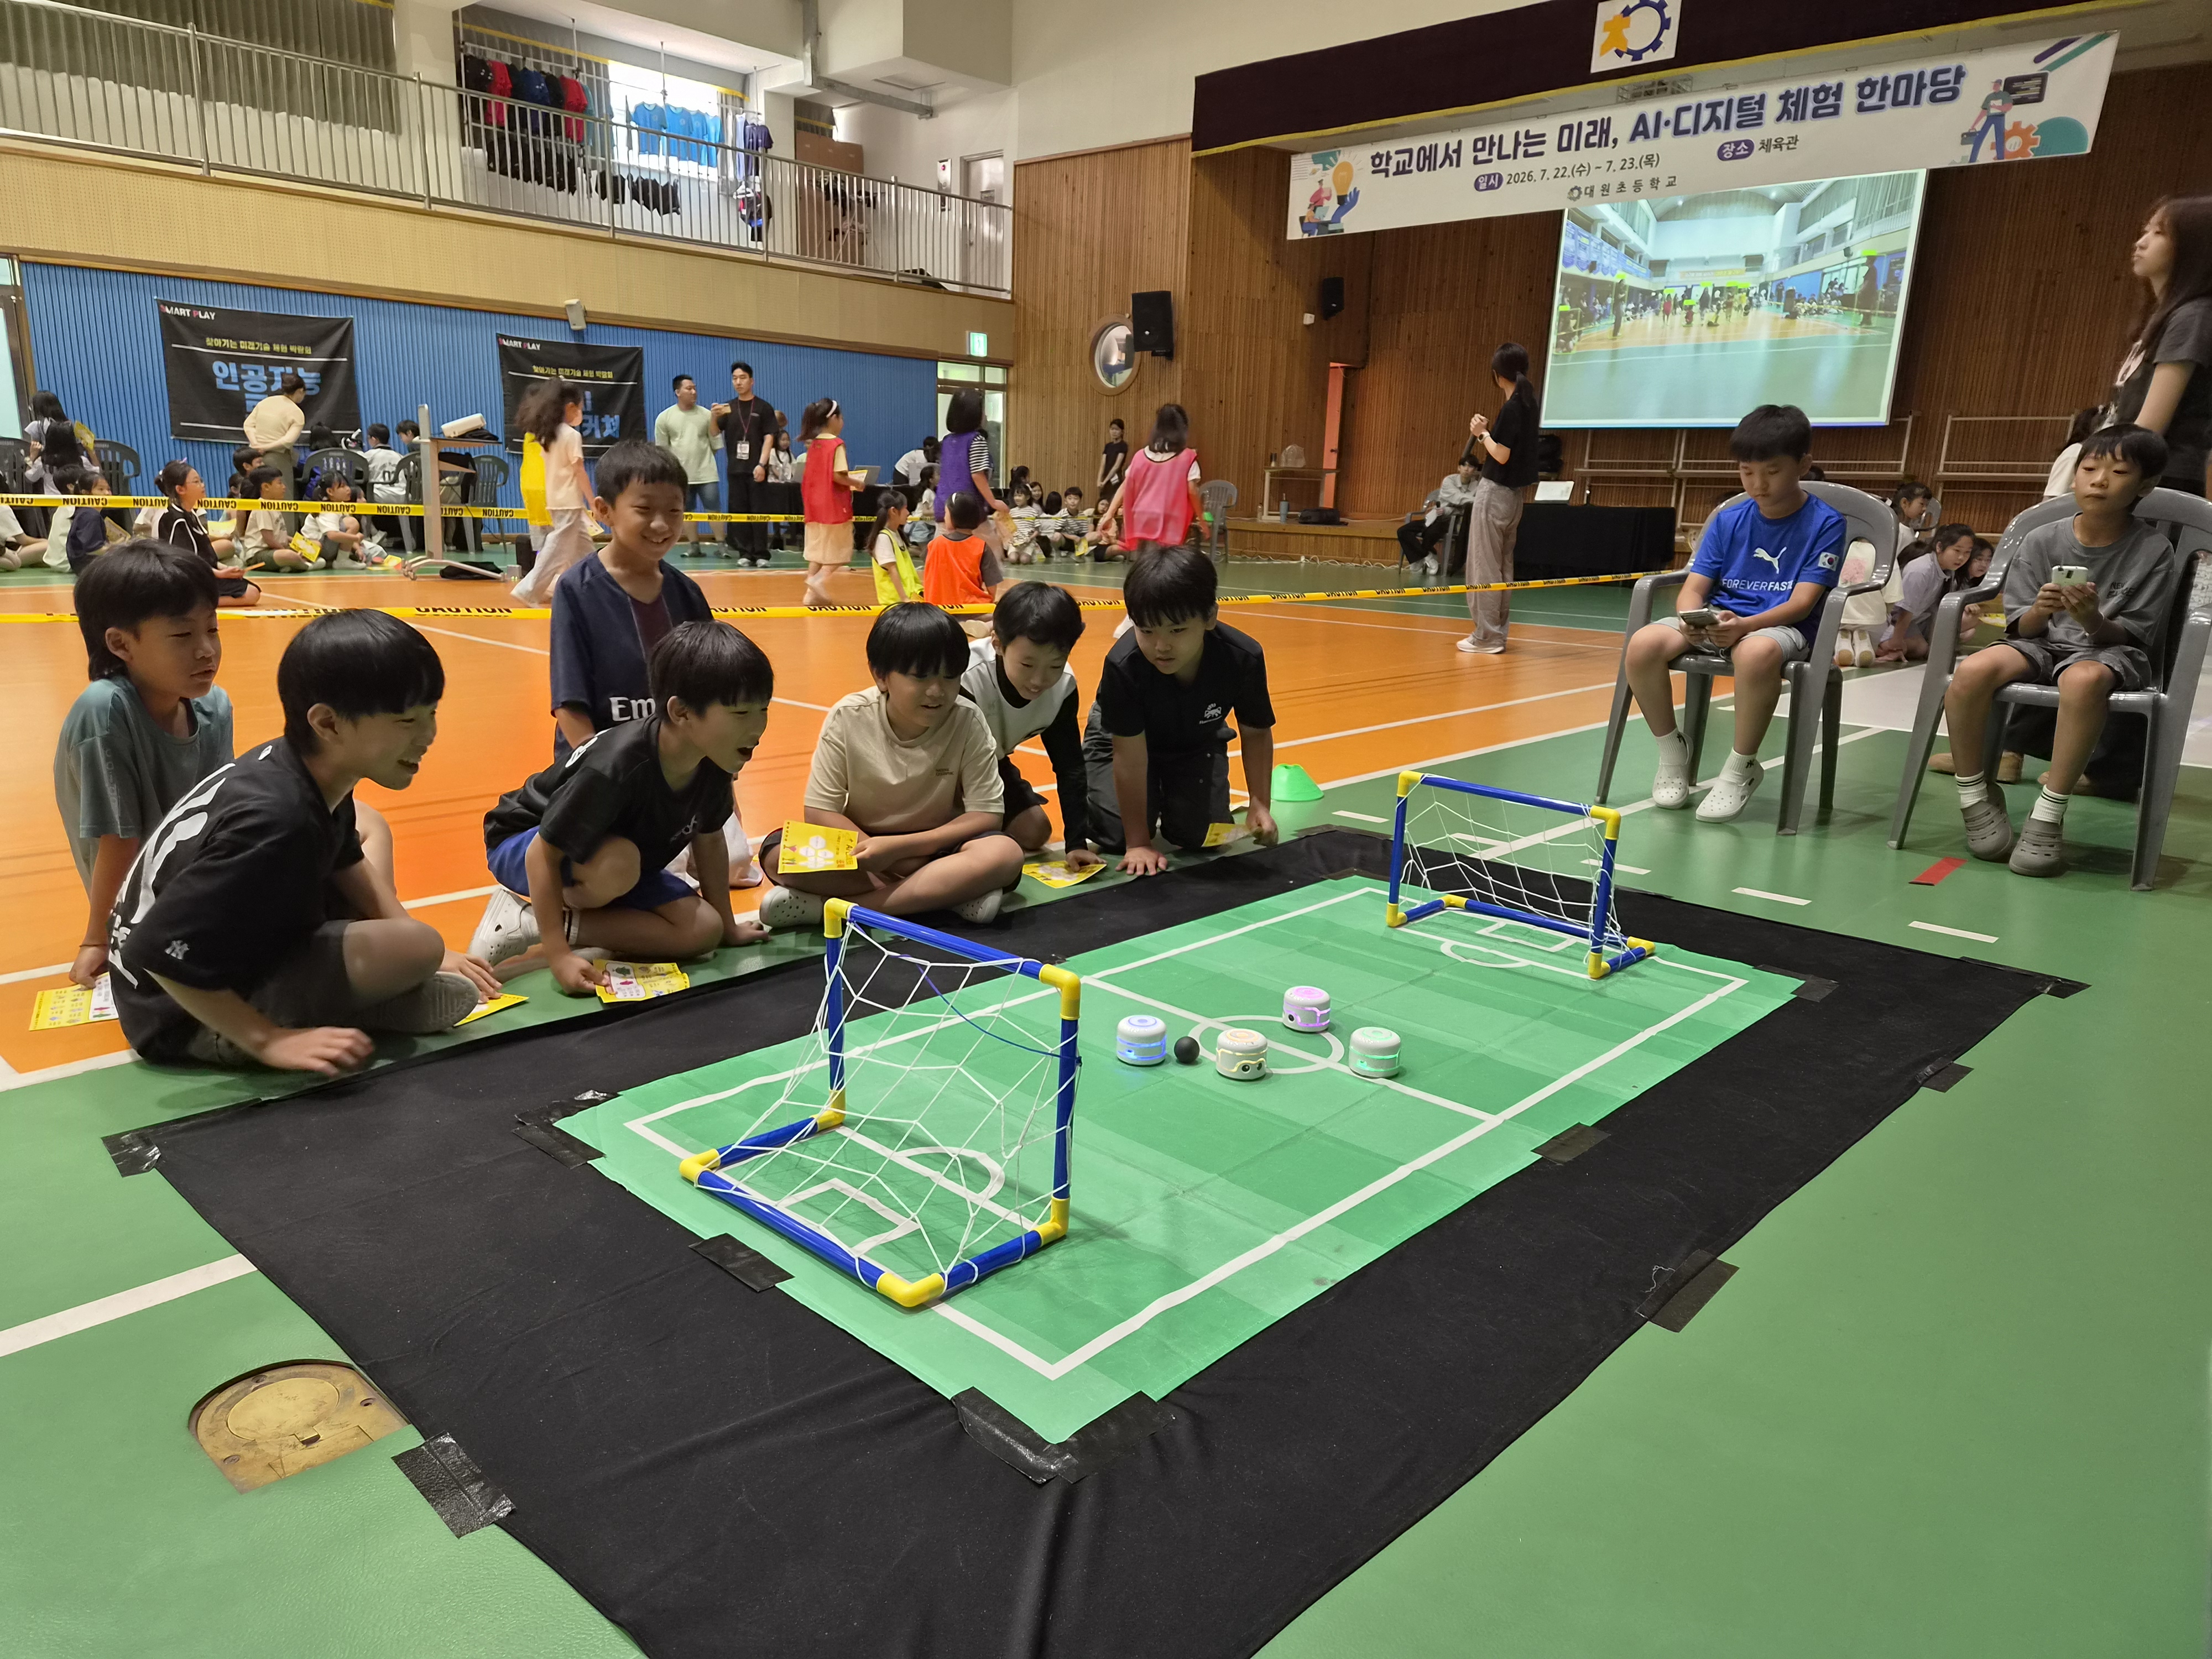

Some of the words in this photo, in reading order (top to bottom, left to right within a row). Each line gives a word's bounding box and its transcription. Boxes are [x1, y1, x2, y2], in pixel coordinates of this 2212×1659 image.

[1370, 139, 1462, 178] 학교에서
[1472, 128, 1547, 165] 만나는
[1557, 116, 1619, 153] 미래,
[1775, 81, 1845, 123] 체험
[1855, 65, 1966, 113] 한마당
[1721, 142, 1750, 160] 장소
[1758, 134, 1799, 154] 체육관
[1478, 173, 1499, 190] 일시
[1506, 170, 1537, 185] 2026.
[1541, 169, 1550, 181] 7.
[1554, 162, 1591, 179] 22.(수)
[1606, 160, 1616, 173] 7.
[1620, 153, 1660, 170] 23.(목)
[160, 304, 191, 317] SMART
[192, 310, 216, 320] PLAY
[62, 497, 108, 506] CAUTION
[133, 498, 168, 507] AUTION
[197, 499, 237, 509] CAUTION
[260, 502, 299, 510] CAUTION
[320, 503, 356, 513] CAUTION
[377, 505, 411, 514] CAUTION
[482, 509, 514, 517] CAUTION
[610, 696, 656, 722] Em
